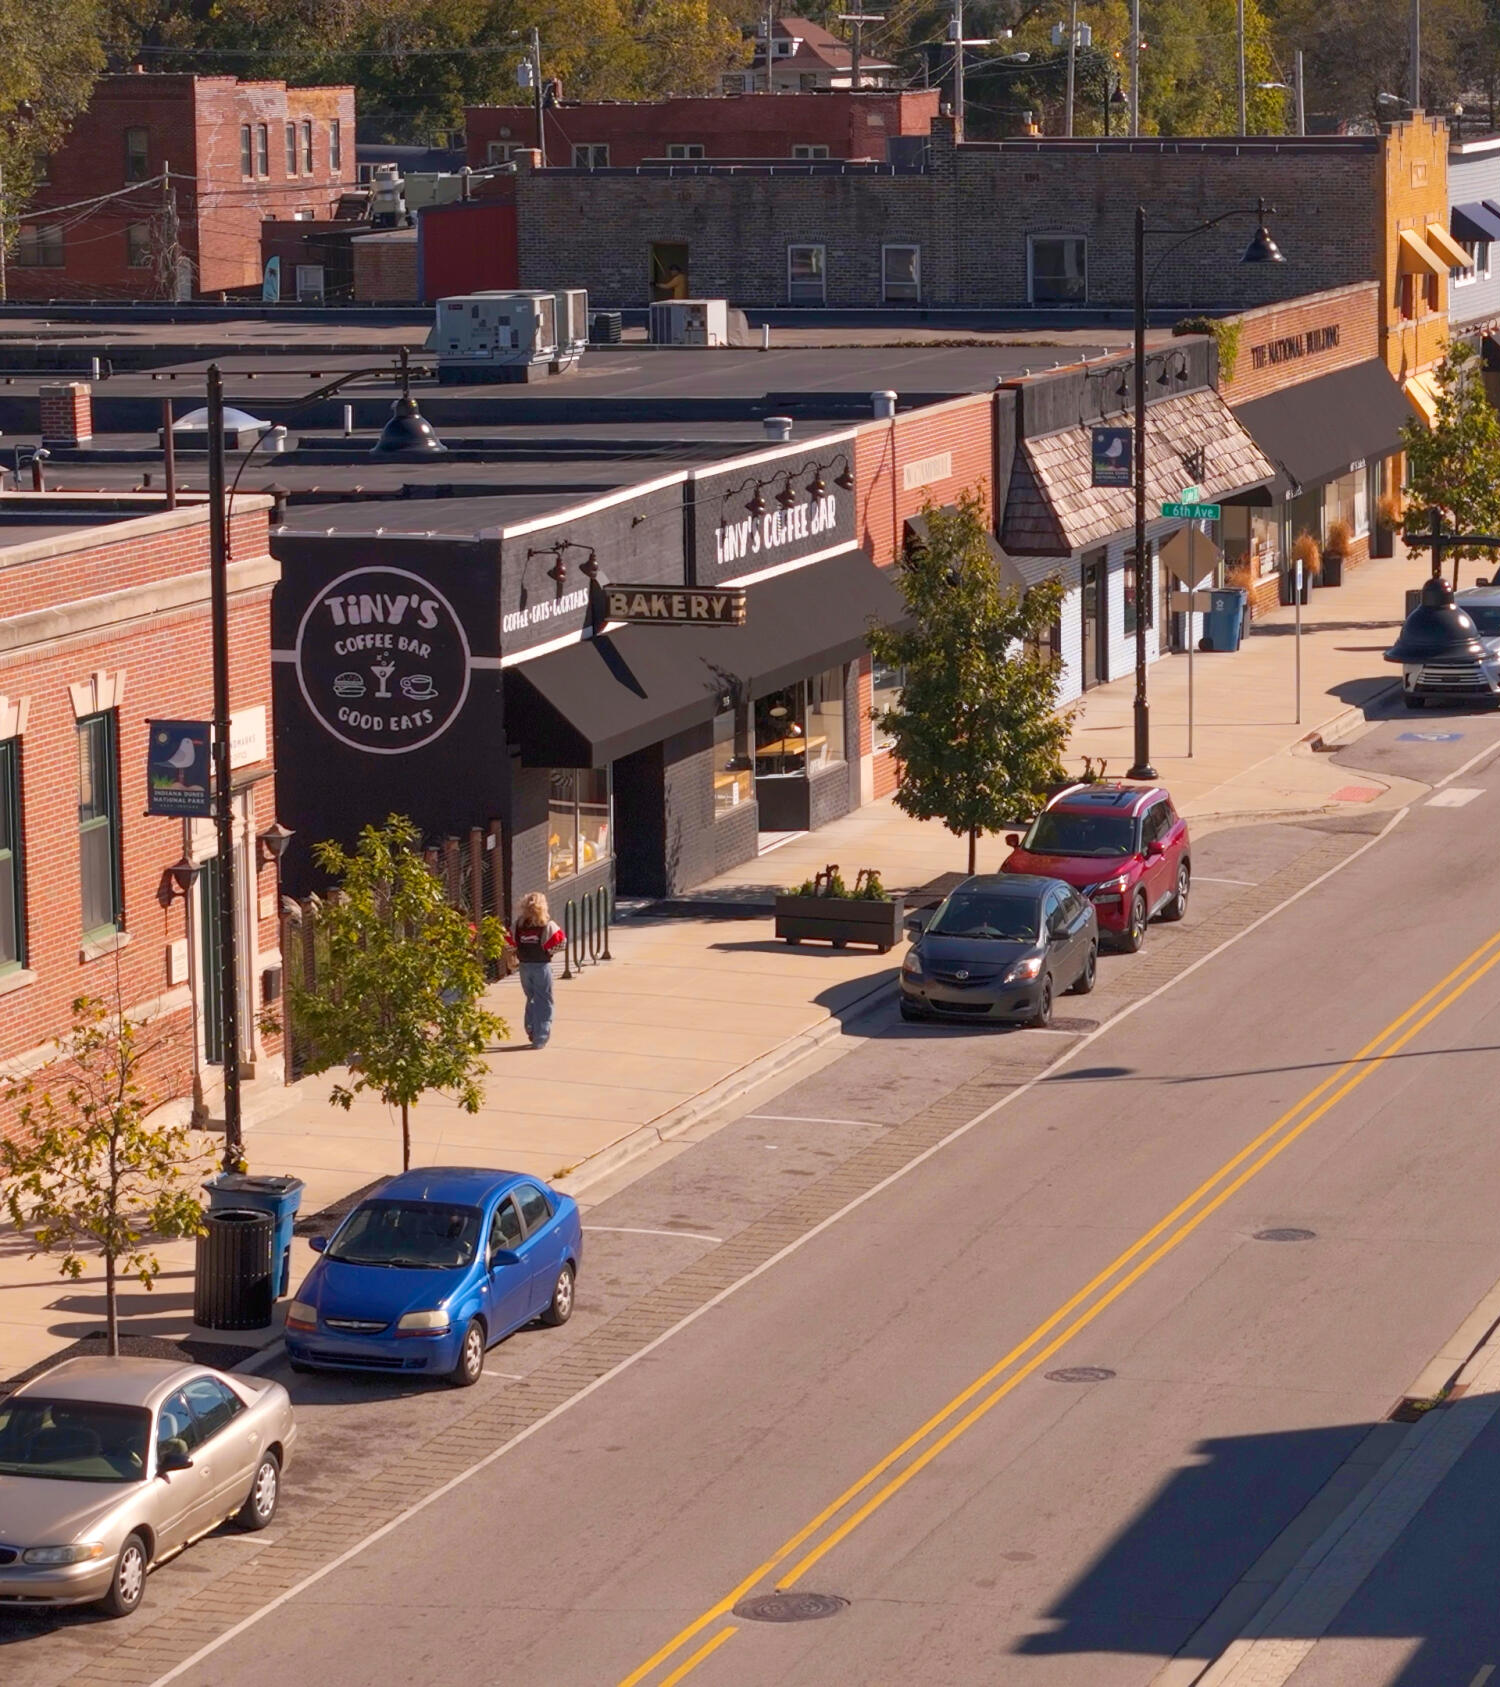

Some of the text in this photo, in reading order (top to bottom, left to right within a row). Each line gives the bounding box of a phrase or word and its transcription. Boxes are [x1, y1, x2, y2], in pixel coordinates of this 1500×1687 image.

[1251, 323, 1339, 370] THE NATIONAL BUILDING
[763, 502, 809, 550] COFFEE
[811, 495, 836, 535] BAR
[1173, 506, 1191, 516] 6th
[503, 588, 589, 633] COFFEE EATS COCKTAILS
[609, 593, 728, 619] BAKERY
[334, 634, 431, 659] COFFEE BAR
[338, 706, 433, 731] GOOD EATS
